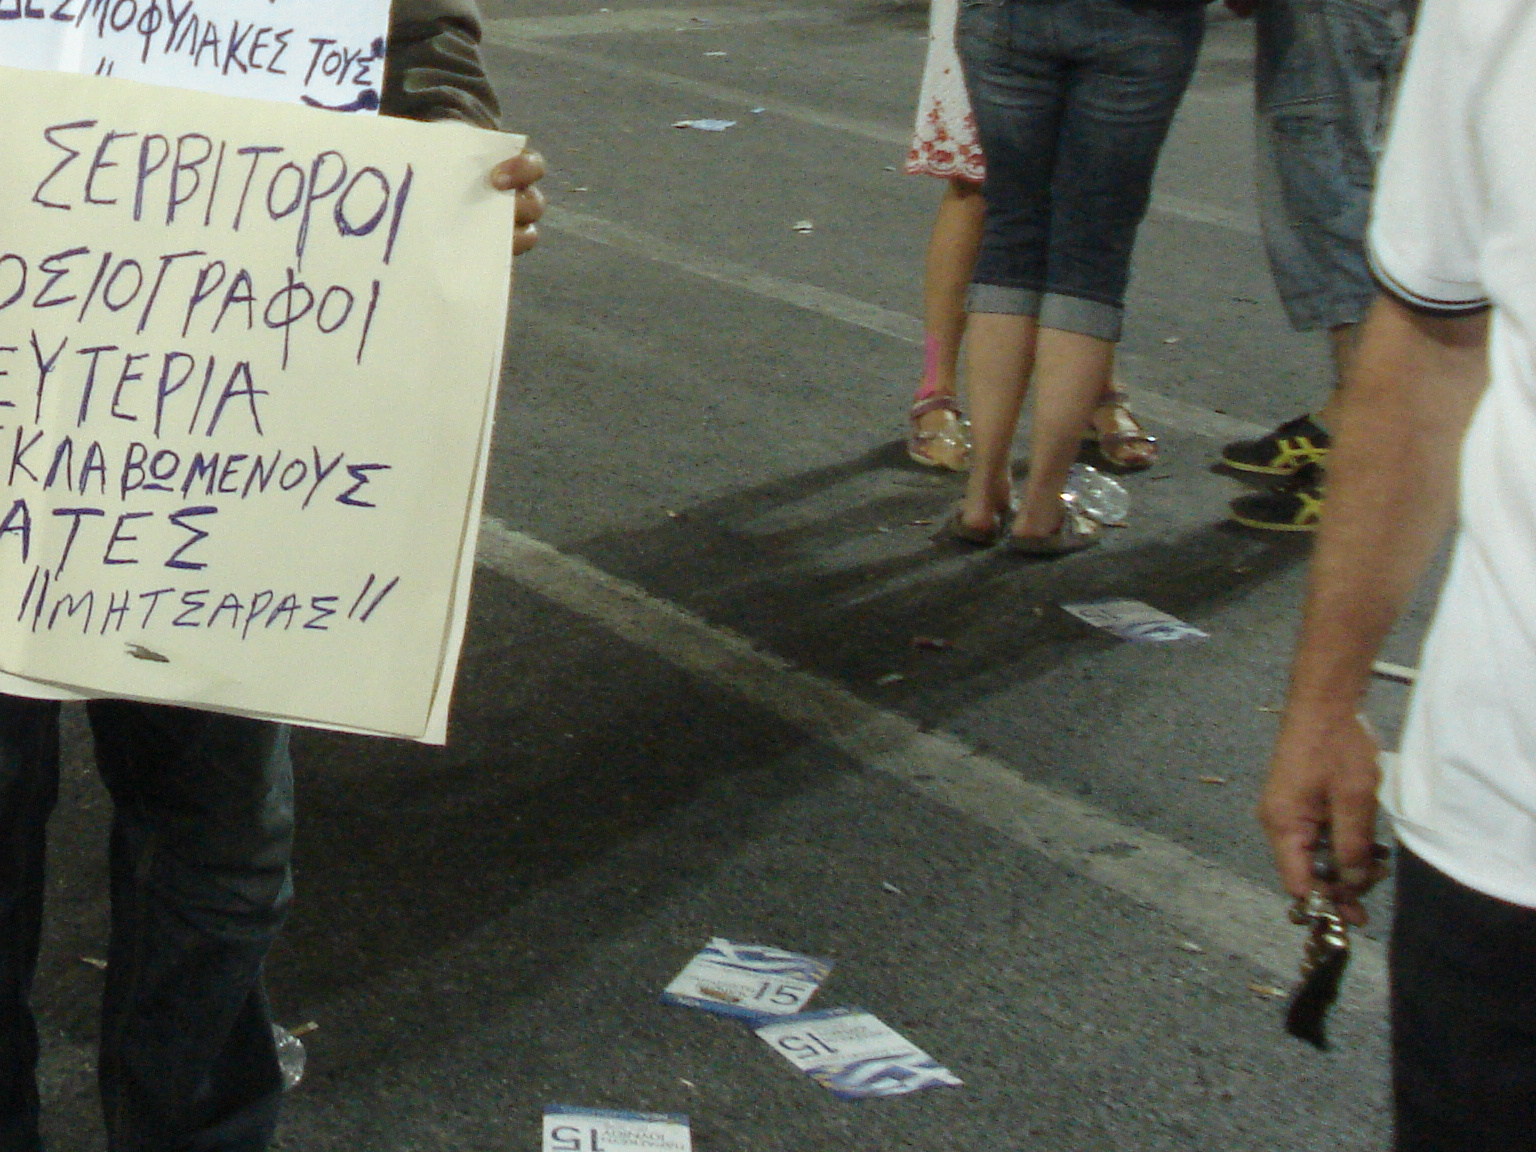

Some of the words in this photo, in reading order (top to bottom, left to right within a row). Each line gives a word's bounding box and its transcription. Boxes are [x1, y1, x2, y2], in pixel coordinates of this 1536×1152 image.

[32, 119, 416, 268] ΣΕΡΒΙΤΟΡΟΙ
[753, 981, 805, 1006] 15
[778, 1032, 839, 1061] 15
[551, 1125, 604, 1152] 15
